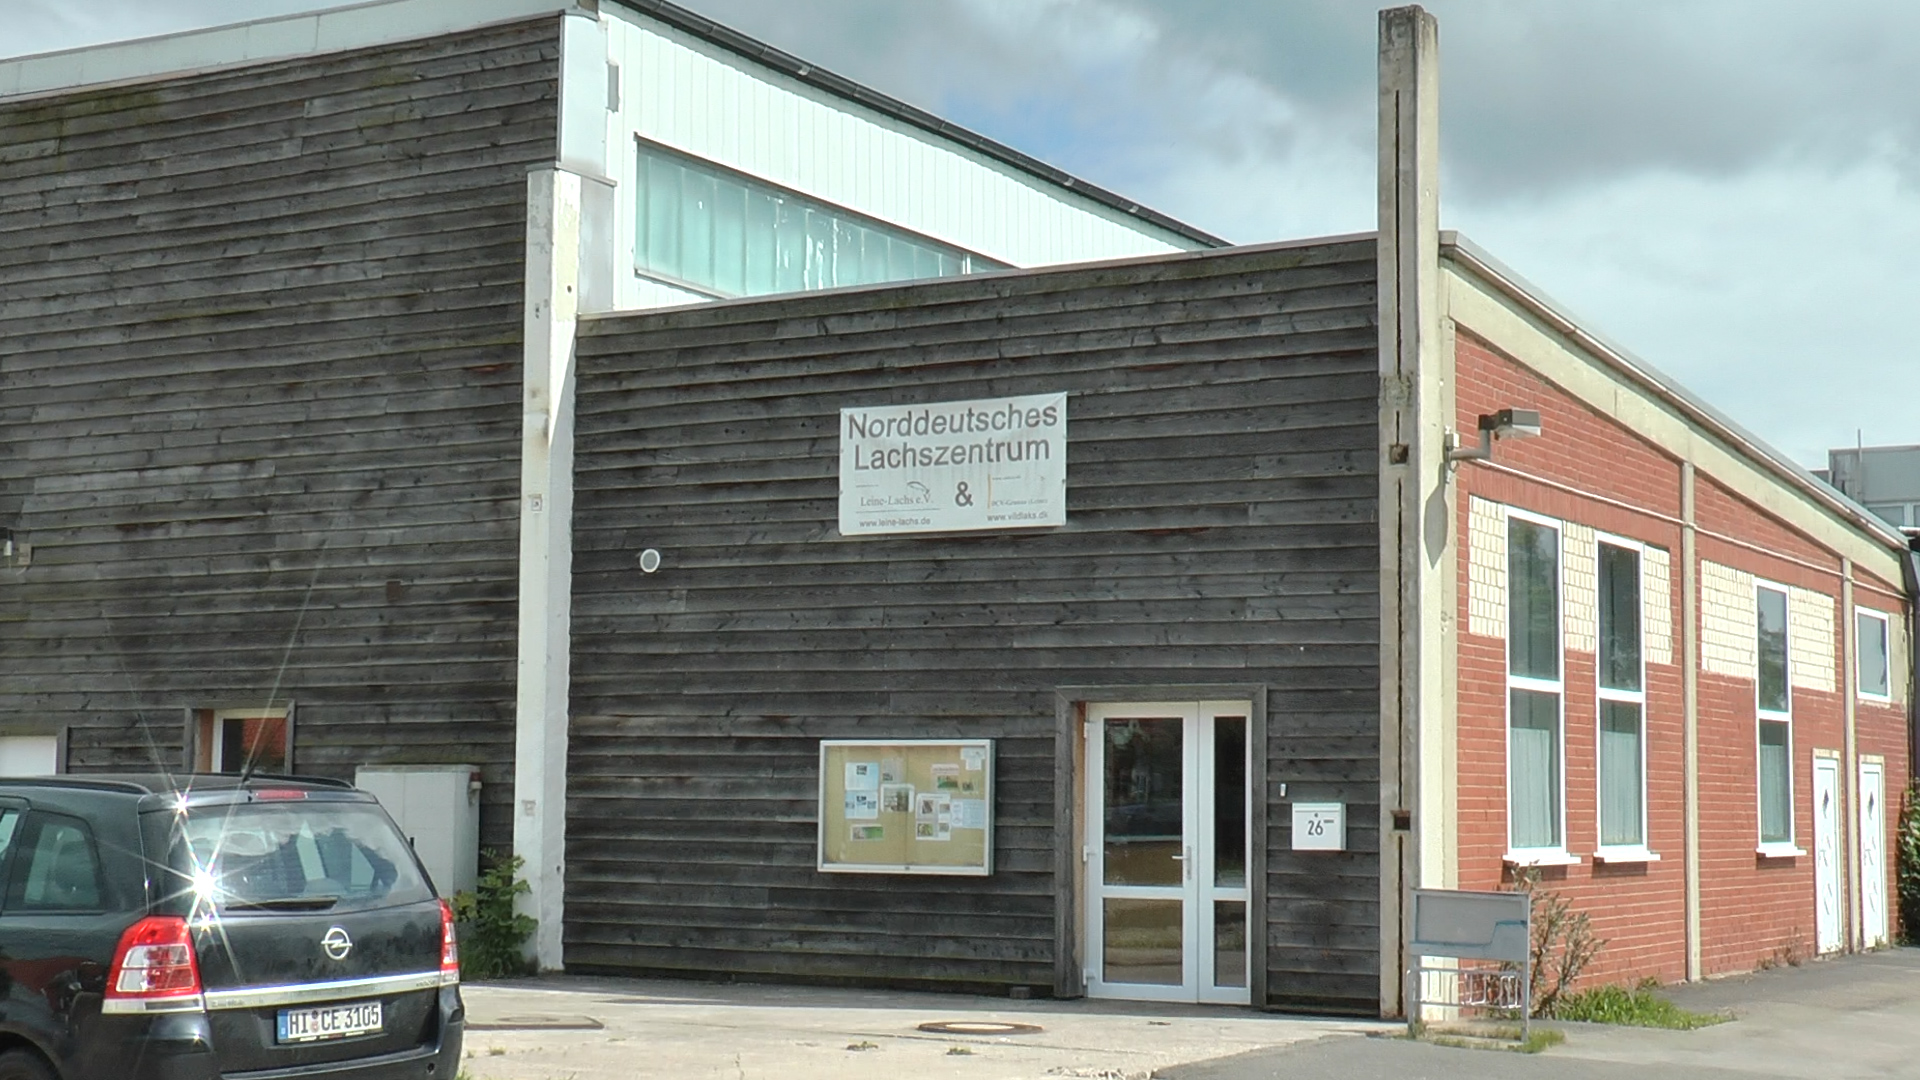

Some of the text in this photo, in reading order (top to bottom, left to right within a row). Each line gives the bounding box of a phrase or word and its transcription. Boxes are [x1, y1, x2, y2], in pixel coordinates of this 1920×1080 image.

[849, 403, 1058, 440] Norddeutsches
[854, 438, 1050, 470] Lachszentrum
[860, 495, 914, 507] Leine-Lachs
[955, 481, 974, 507] &
[859, 517, 931, 527] www.leine-lachs.de
[1307, 820, 1324, 836] 26
[289, 1005, 379, 1035] HI CE 3105
